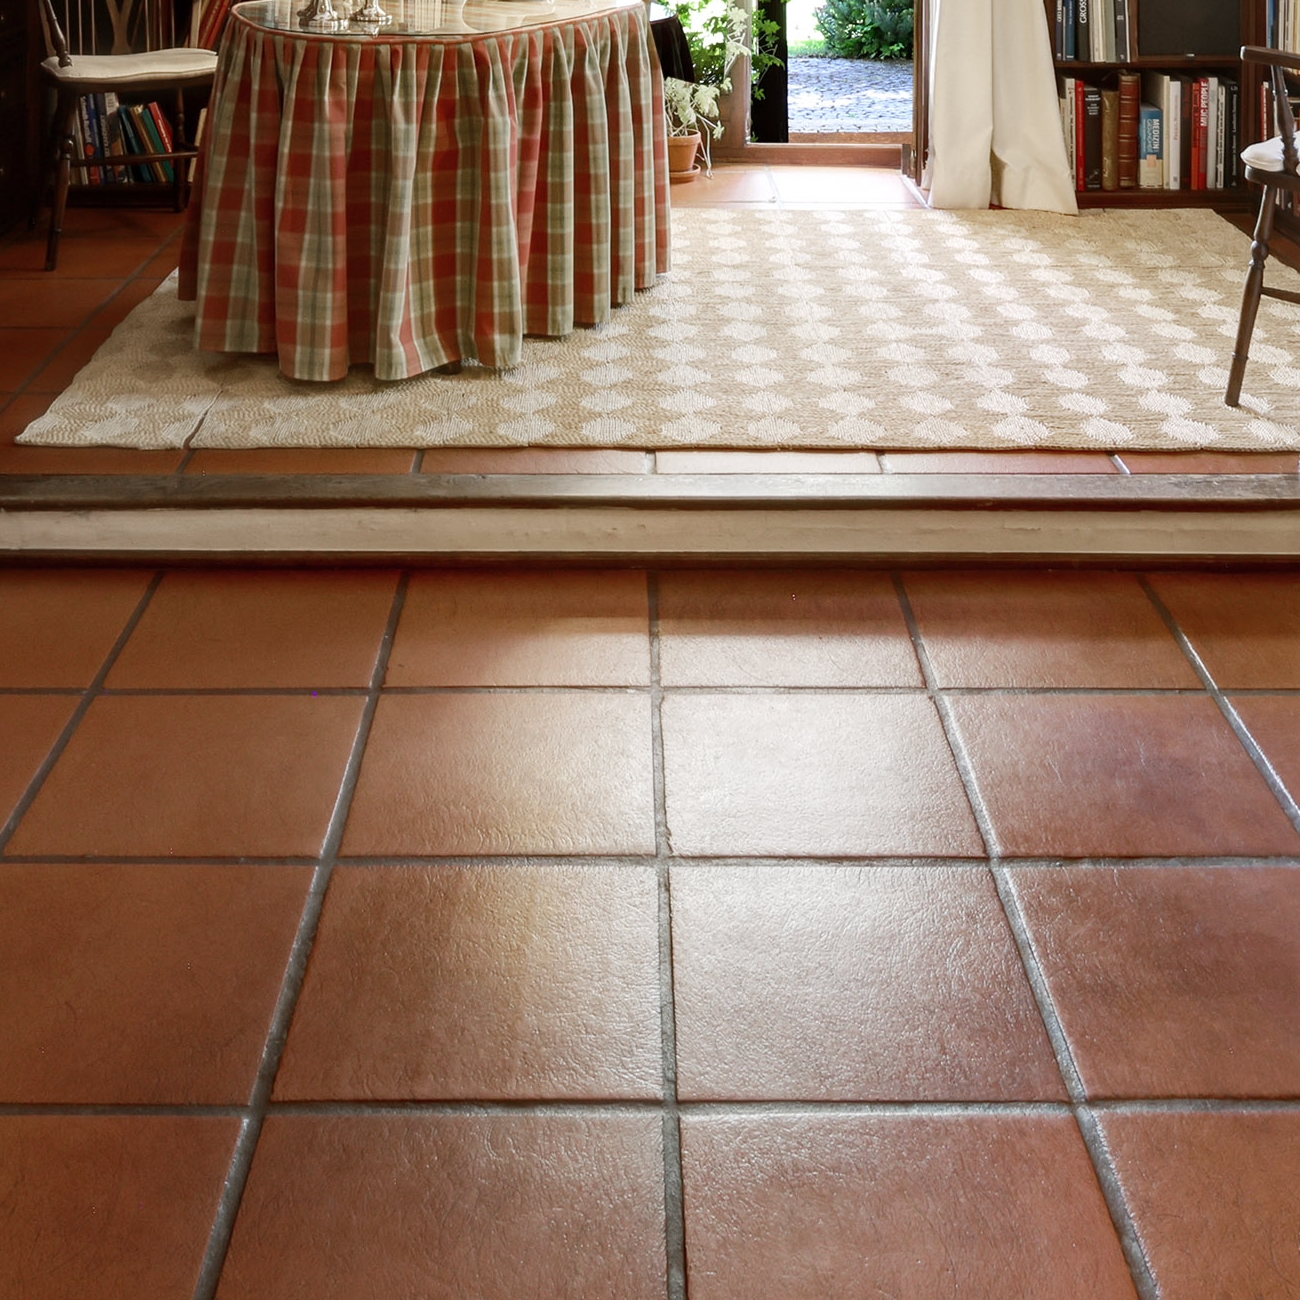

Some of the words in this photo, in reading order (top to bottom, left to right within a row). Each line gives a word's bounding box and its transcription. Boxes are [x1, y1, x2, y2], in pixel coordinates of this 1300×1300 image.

[1200, 81, 1208, 108] PEOPLE
[1200, 109, 1208, 127] MUC
[1152, 118, 1160, 149] MEDIZIN
